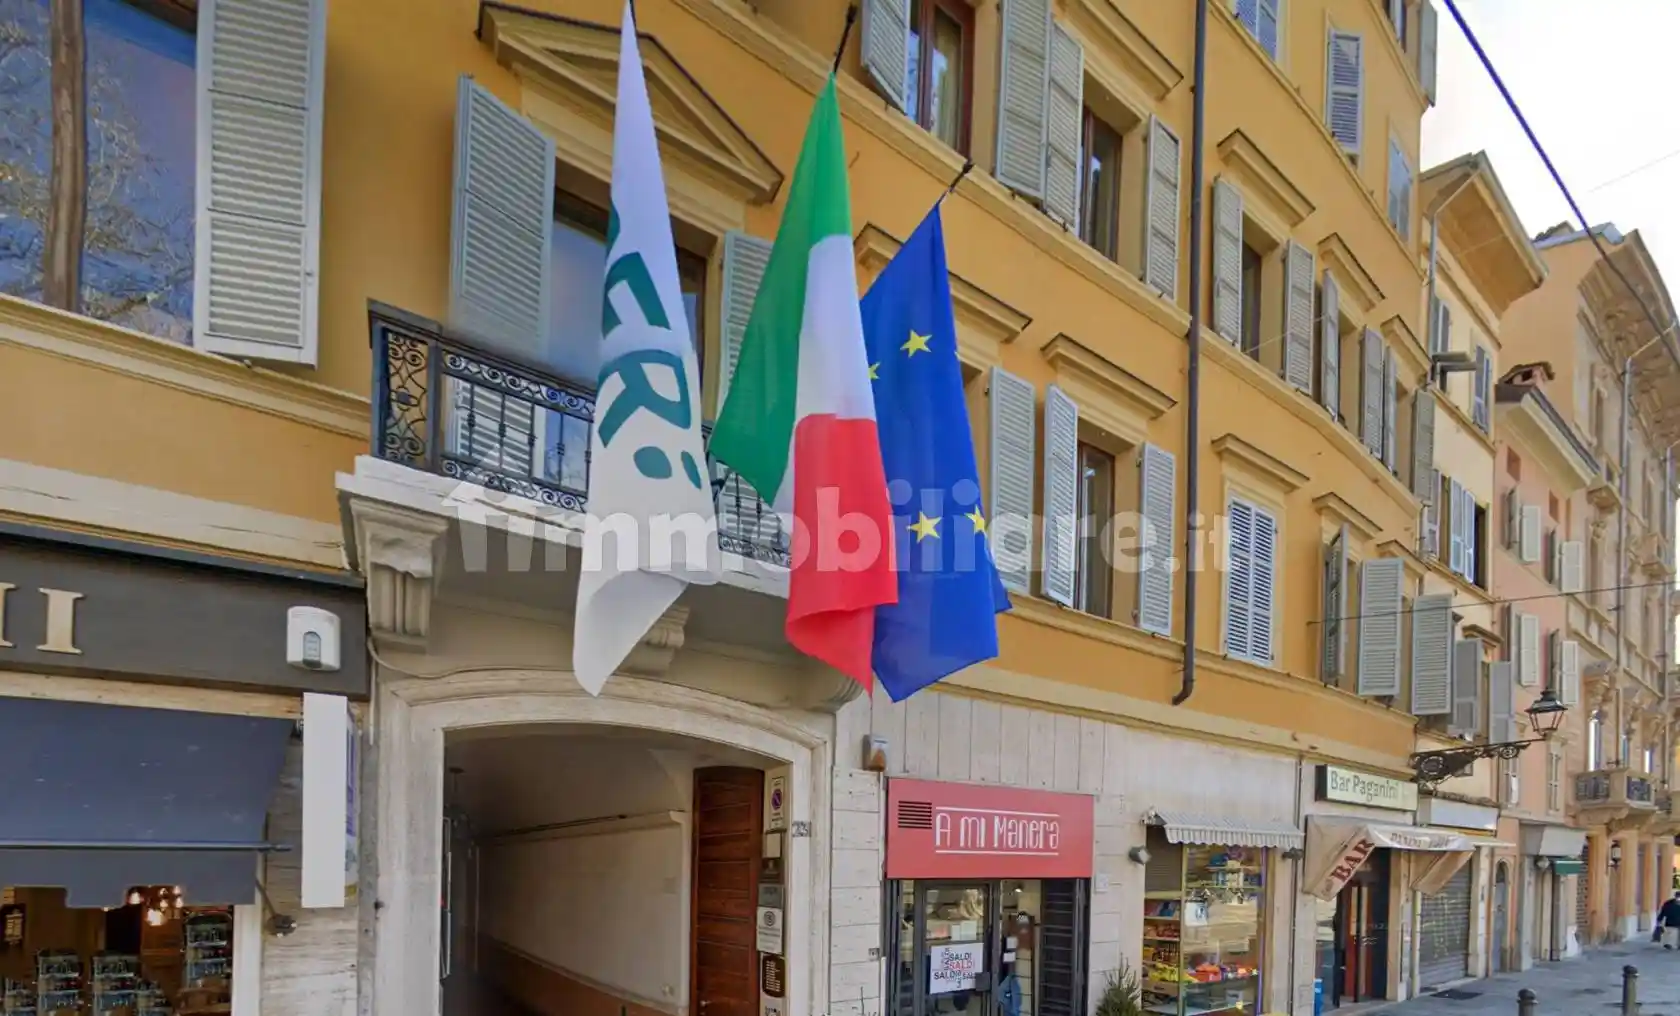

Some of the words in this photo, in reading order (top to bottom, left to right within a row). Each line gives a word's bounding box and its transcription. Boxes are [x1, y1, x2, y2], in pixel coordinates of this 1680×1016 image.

[1330, 770, 1351, 793] Bar
[935, 812, 952, 847] A
[993, 815, 1060, 850] Manera
[1330, 838, 1376, 882] BAR
[949, 952, 973, 961] SALDI
[950, 959, 976, 970] SALDI
